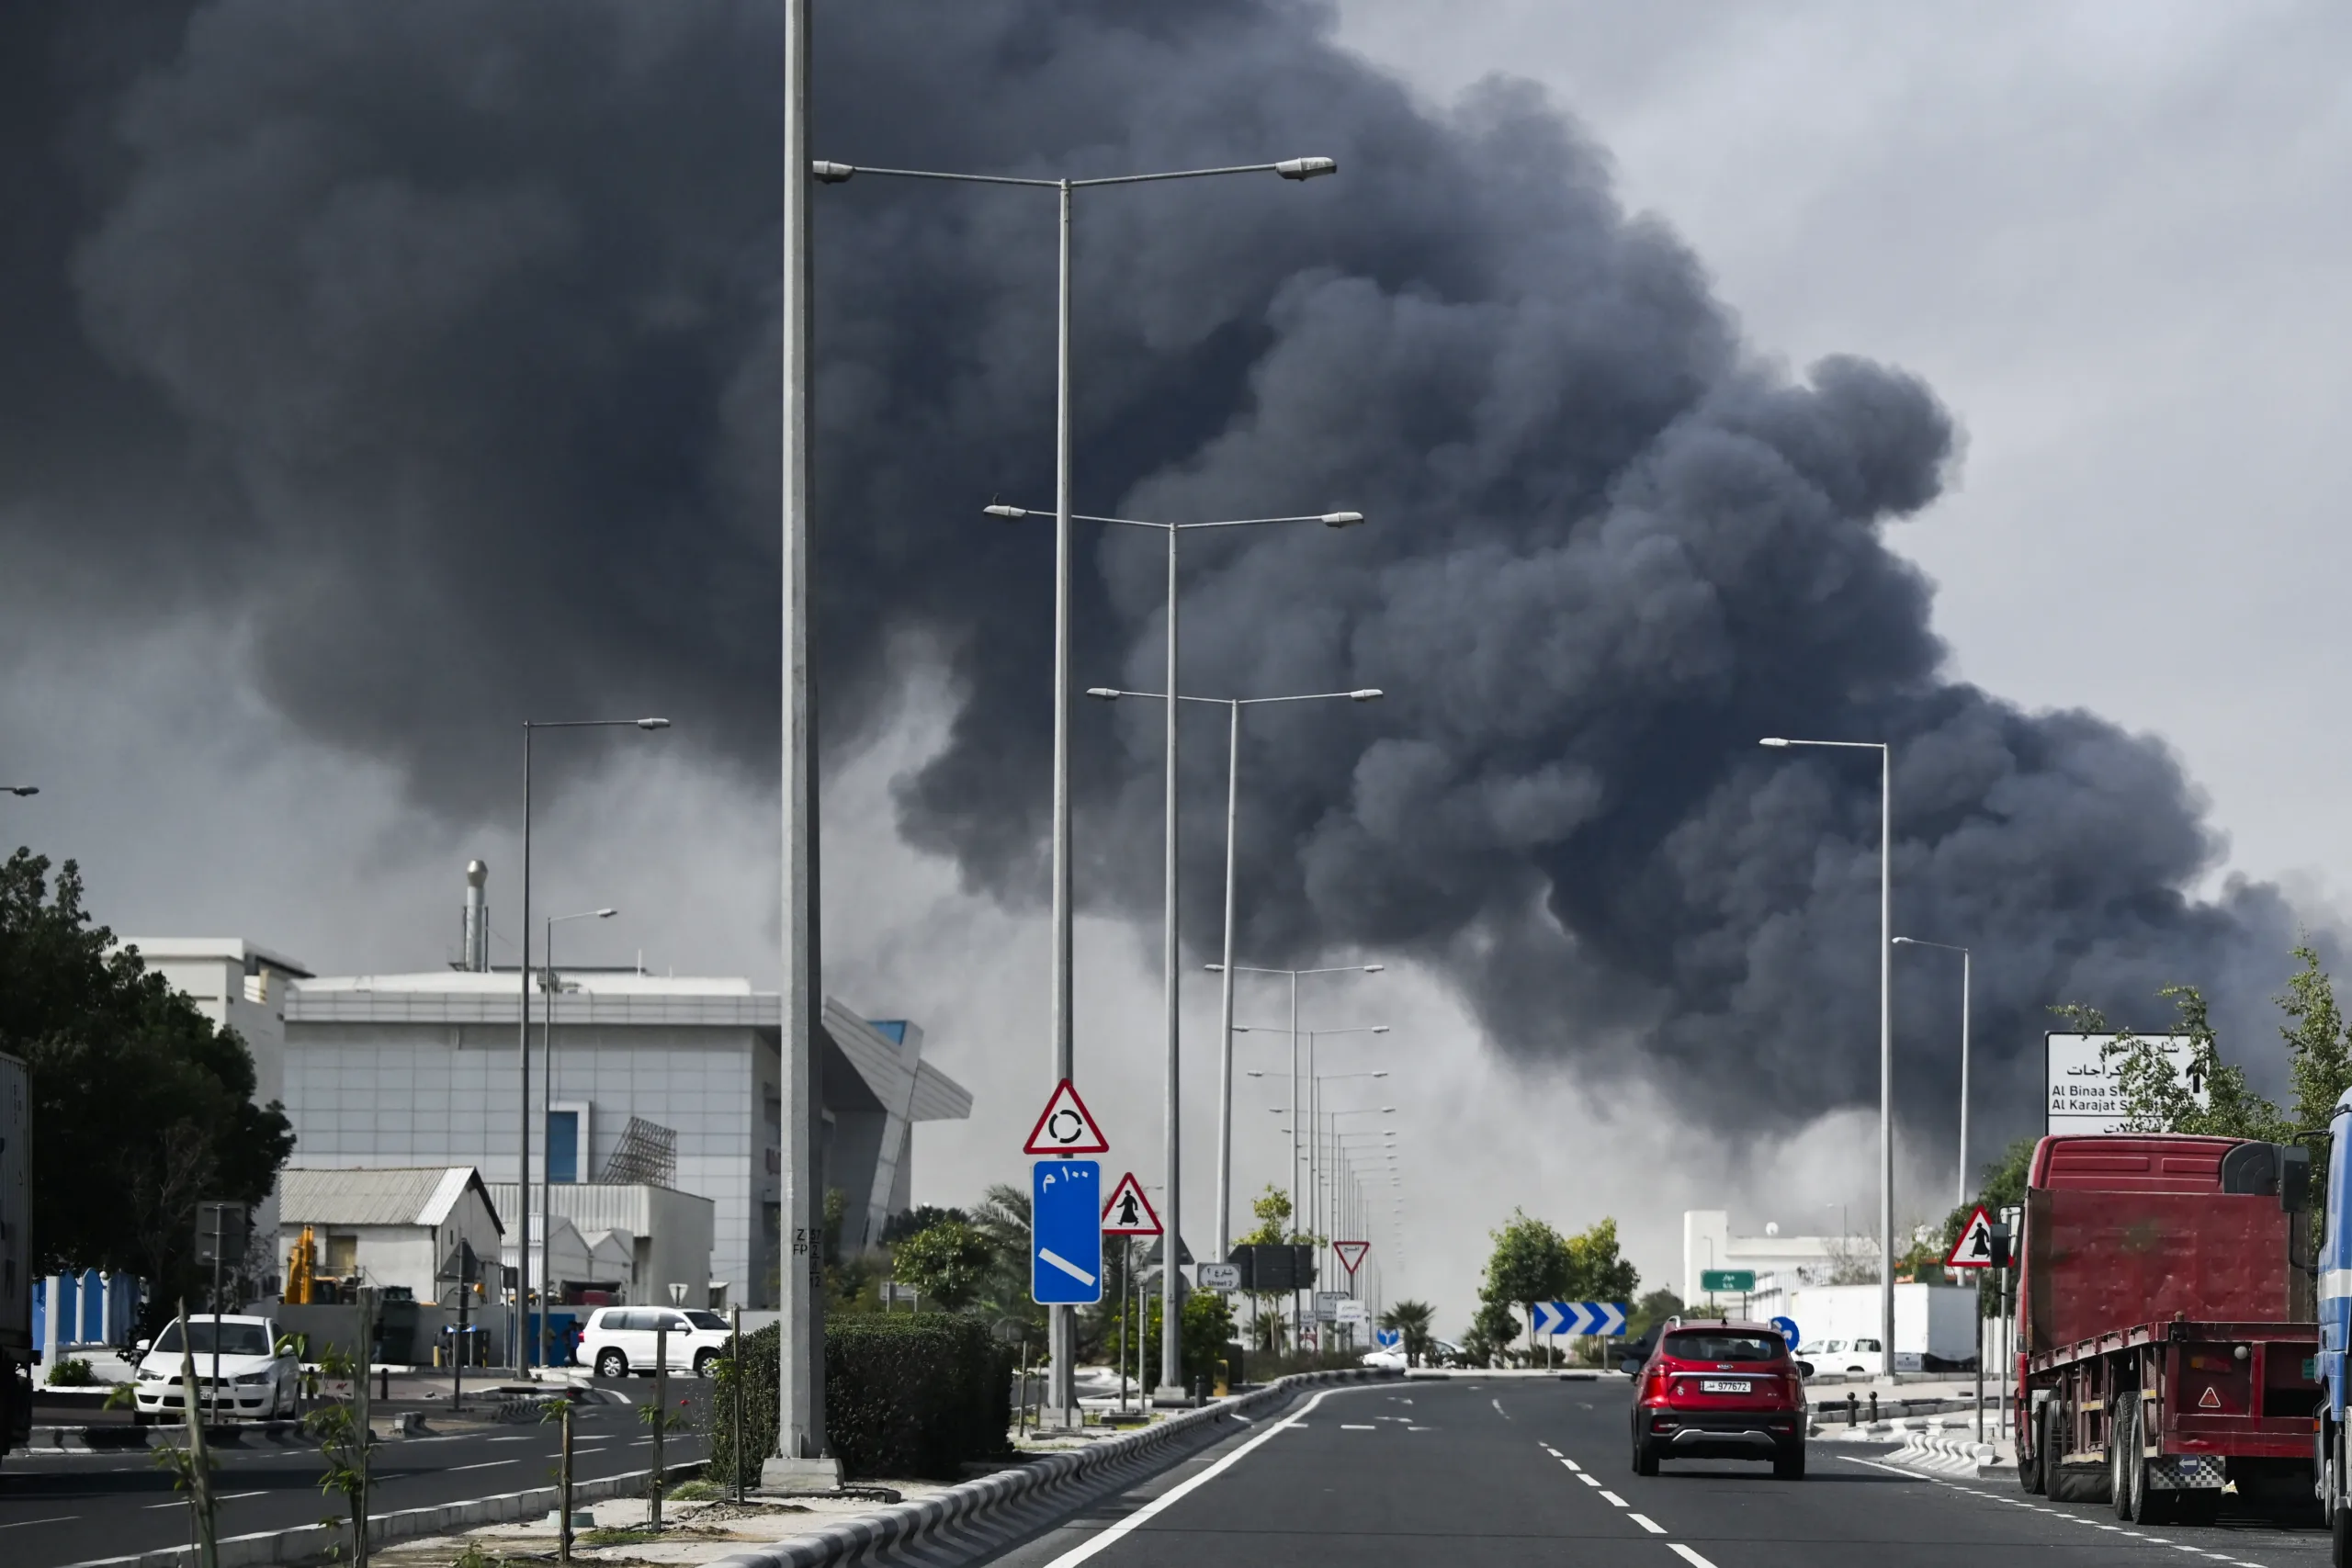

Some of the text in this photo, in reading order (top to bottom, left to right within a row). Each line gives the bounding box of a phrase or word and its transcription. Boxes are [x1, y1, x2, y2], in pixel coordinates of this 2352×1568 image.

[2052, 1086, 2065, 1096] Al
[2069, 1086, 2105, 1097] Binaa
[2052, 1100, 2065, 1111] Al
[2069, 1100, 2116, 1112] Karajat
[1043, 1166, 1089, 1194] ١٠٠ م
[797, 1228, 806, 1241] Z
[793, 1244, 808, 1256] FP
[1717, 1382, 1747, 1391] 977672
